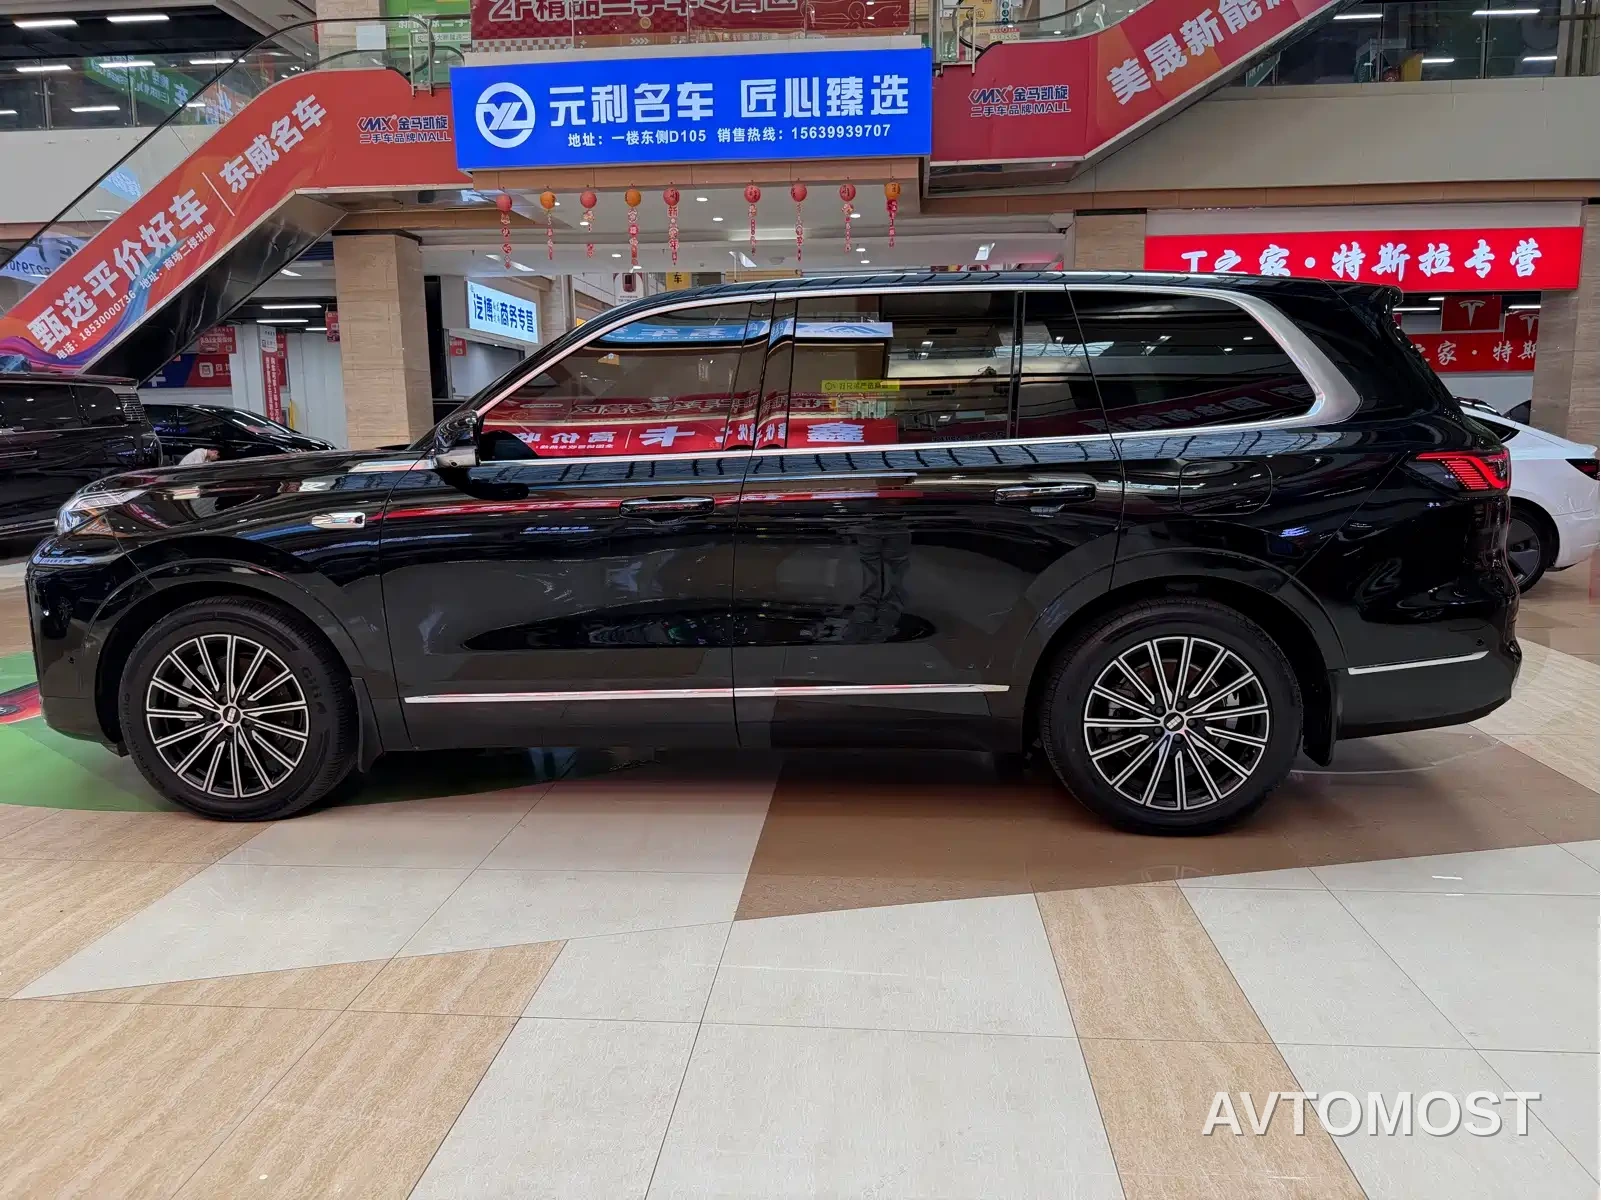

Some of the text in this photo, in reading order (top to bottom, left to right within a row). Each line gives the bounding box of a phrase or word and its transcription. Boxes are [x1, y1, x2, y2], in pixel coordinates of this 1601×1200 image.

[549, 74, 909, 127] 元利名车 匠心臻选
[1013, 85, 1069, 102] 金马凯旋
[971, 102, 1071, 117] 二手车品牌MALL
[398, 115, 448, 131] 金马凯旋
[360, 131, 452, 144] 二手车品牌MALL
[27, 94, 327, 352] 甄选平价好车 东威名车
[499, 302, 535, 333] 商务专营
